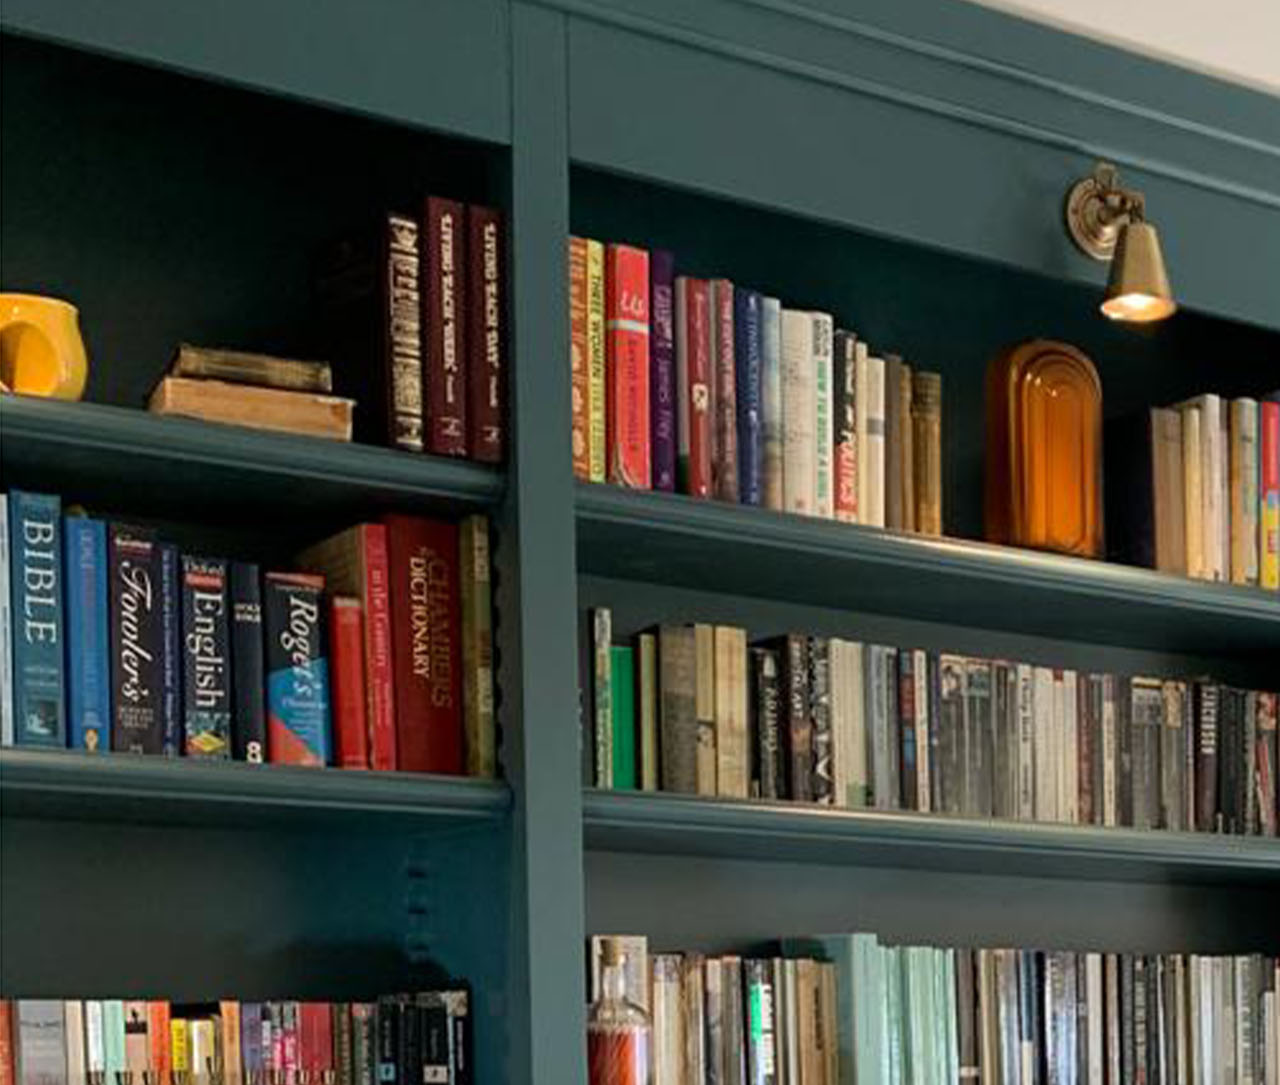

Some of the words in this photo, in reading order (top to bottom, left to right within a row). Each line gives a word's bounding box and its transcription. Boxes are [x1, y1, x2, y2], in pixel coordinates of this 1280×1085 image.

[23, 518, 57, 644] BIBLE
[121, 561, 153, 702] Fowler's
[410, 556, 430, 679] DICTIONARY
[186, 591, 224, 708] English
[280, 596, 319, 697] Roget's
